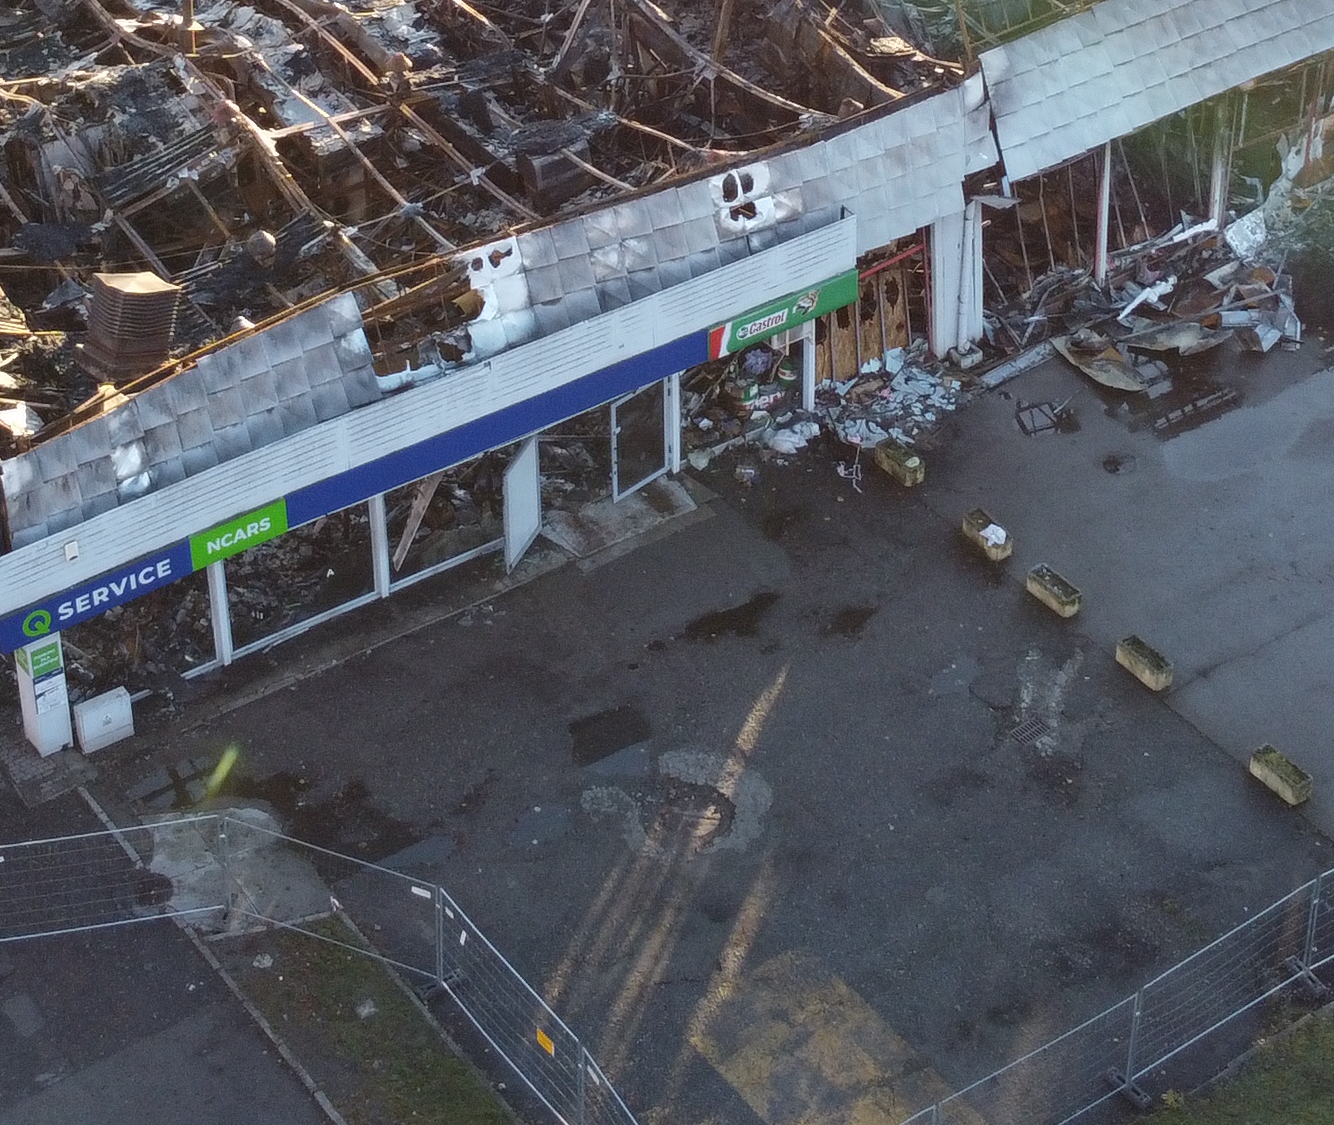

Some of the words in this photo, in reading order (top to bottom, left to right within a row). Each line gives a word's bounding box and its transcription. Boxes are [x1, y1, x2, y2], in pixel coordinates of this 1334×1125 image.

[749, 310, 786, 336] Castrol
[206, 517, 272, 555] NCARS
[58, 558, 172, 621] SERVICE
